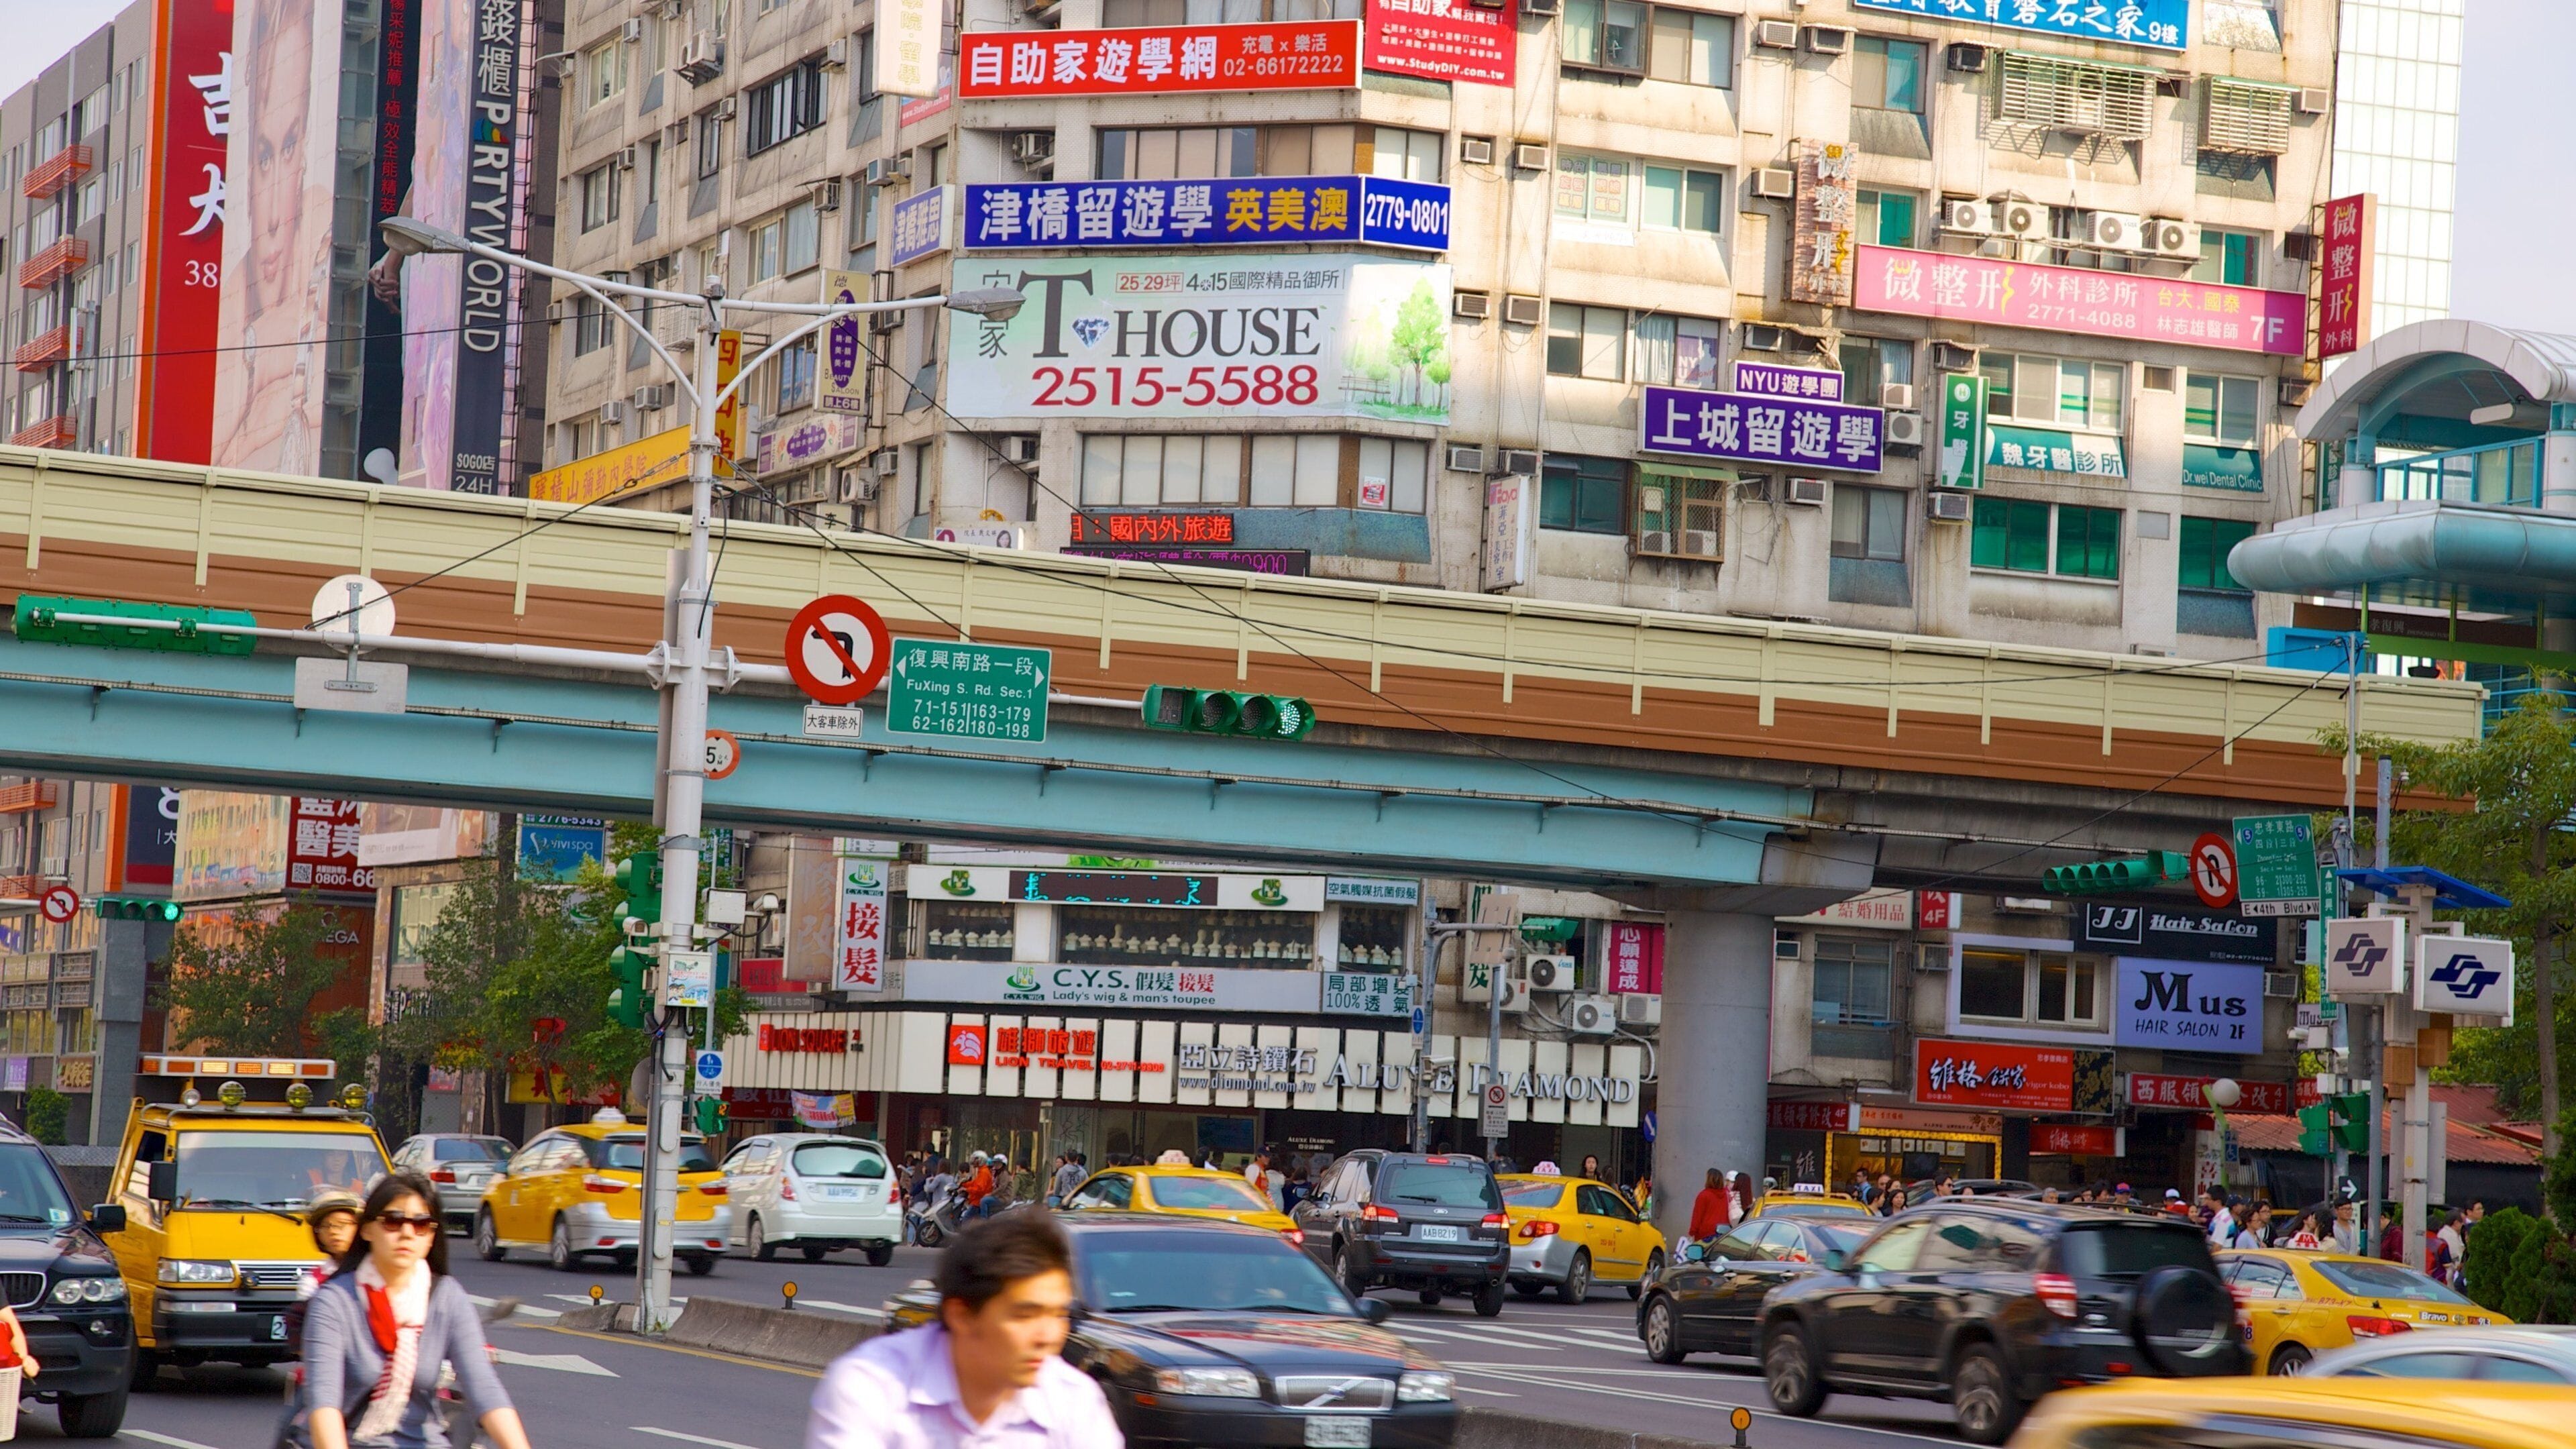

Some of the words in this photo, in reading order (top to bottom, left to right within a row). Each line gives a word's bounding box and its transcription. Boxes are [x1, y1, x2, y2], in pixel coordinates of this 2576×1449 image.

[1242, 35, 1273, 54] 充電
[1295, 33, 1327, 53] 樂活
[2149, 22, 2179, 45] 9樓
[971, 36, 1218, 86] 自助家遊學網
[1224, 54, 1344, 76] 02-66172222
[1377, 54, 1505, 80] www.StudyDIY.com.tw
[980, 185, 1213, 242] 津橋留遊學
[1226, 186, 1348, 233] 英美澳
[1366, 192, 1450, 235] 2779-0801
[893, 195, 941, 256] 津橋雅思
[2327, 203, 2357, 324] 微整形
[1119, 273, 1182, 291] 25-29坪
[1882, 256, 2015, 317] 微整形
[2028, 274, 2138, 309] 外科診所
[2027, 303, 2137, 330] 2771-4088
[1112, 307, 1321, 359] HOUSE
[2157, 316, 2239, 341] 林志雄醫師
[2249, 315, 2286, 344] 7F
[2325, 327, 2353, 351] 外科
[831, 382, 859, 396] SALOON
[1031, 364, 1320, 407] 2515-5588
[1741, 368, 1839, 399] NYU遊學團
[1652, 397, 1876, 463] 上城留遊學
[1953, 410, 1970, 457] 牙醫
[456, 453, 496, 471] SOGO店
[2001, 442, 2121, 476] 魏牙醫診所
[455, 475, 493, 494] 24H
[2183, 470, 2209, 485] Dr.wei
[2209, 472, 2238, 488] Dental
[2238, 474, 2263, 490] Clinic
[2357, 618, 2406, 634] 孝復興
[909, 647, 1034, 677] 復興南路一段
[907, 679, 950, 696] FuXing
[957, 682, 969, 695] S.
[975, 683, 995, 697] Rd.
[1000, 685, 1033, 700] Sec.1
[807, 714, 859, 731] 大客車除外
[2245, 830, 2251, 840] 5
[2254, 820, 2295, 835] 忠孝東路
[2298, 827, 2304, 837] 5
[572, 841, 594, 854] spa
[1328, 882, 1417, 900] 空氣觸媒抗菌假髮
[1837, 900, 1904, 922] 結婚用品
[1924, 909, 1945, 923] 4F
[2092, 906, 2139, 930] JJ
[2244, 905, 2251, 914] E
[2259, 904, 2276, 914] 4th
[2284, 902, 2307, 914] Blvd.
[2150, 914, 2196, 931] Hair
[843, 901, 881, 985] 接髮
[1617, 927, 1641, 991] 心願達成
[1053, 968, 1130, 989] C.Y.S.
[1136, 971, 1175, 992] 假髮
[1179, 972, 1215, 994] 接髮
[1328, 975, 1409, 996] 局部增髮
[1053, 989, 1090, 1003] Lady's
[1094, 992, 1115, 1004] wig
[1120, 993, 1128, 1002] &
[1132, 994, 1169, 1004] man's
[1173, 995, 1216, 1006] toupee
[1326, 993, 1360, 1009] 100%
[1364, 995, 1409, 1014] 透氣
[2135, 970, 2247, 1017] Mus
[2136, 1018, 2169, 1034] HAIR
[2177, 1020, 2220, 1038] SALON
[2230, 1024, 2246, 1040] 2F
[772, 1027, 799, 1053] LION
[800, 1028, 848, 1054] SQUARE
[997, 1026, 1095, 1057] 雄獅旅遊
[996, 1057, 1030, 1069] LION
[1039, 1057, 1095, 1071] TRAVEL
[1179, 1042, 1318, 1075] 亞立詩鑽石
[696, 1080, 721, 1089] 行人優先
[1179, 1073, 1316, 1094] www.diamond.com.tw
[1324, 1053, 1455, 1094] ALUE
[1468, 1062, 1635, 1104] DIAMOND
[1929, 1057, 2027, 1092] 維格餅家
[2026, 1081, 2047, 1091] vigor
[2049, 1081, 2070, 1090] kobo
[2137, 1079, 2270, 1110] 西服領改
[1766, 1104, 1832, 1129] 服領帶修改
[1835, 1108, 1846, 1117] 4F
[1309, 1137, 1336, 1145] DIAMOND
[1796, 1185, 1823, 1193] TAXI
[1421, 1226, 1458, 1240] AAB8219
[2420, 1311, 2448, 1322] Bravo
